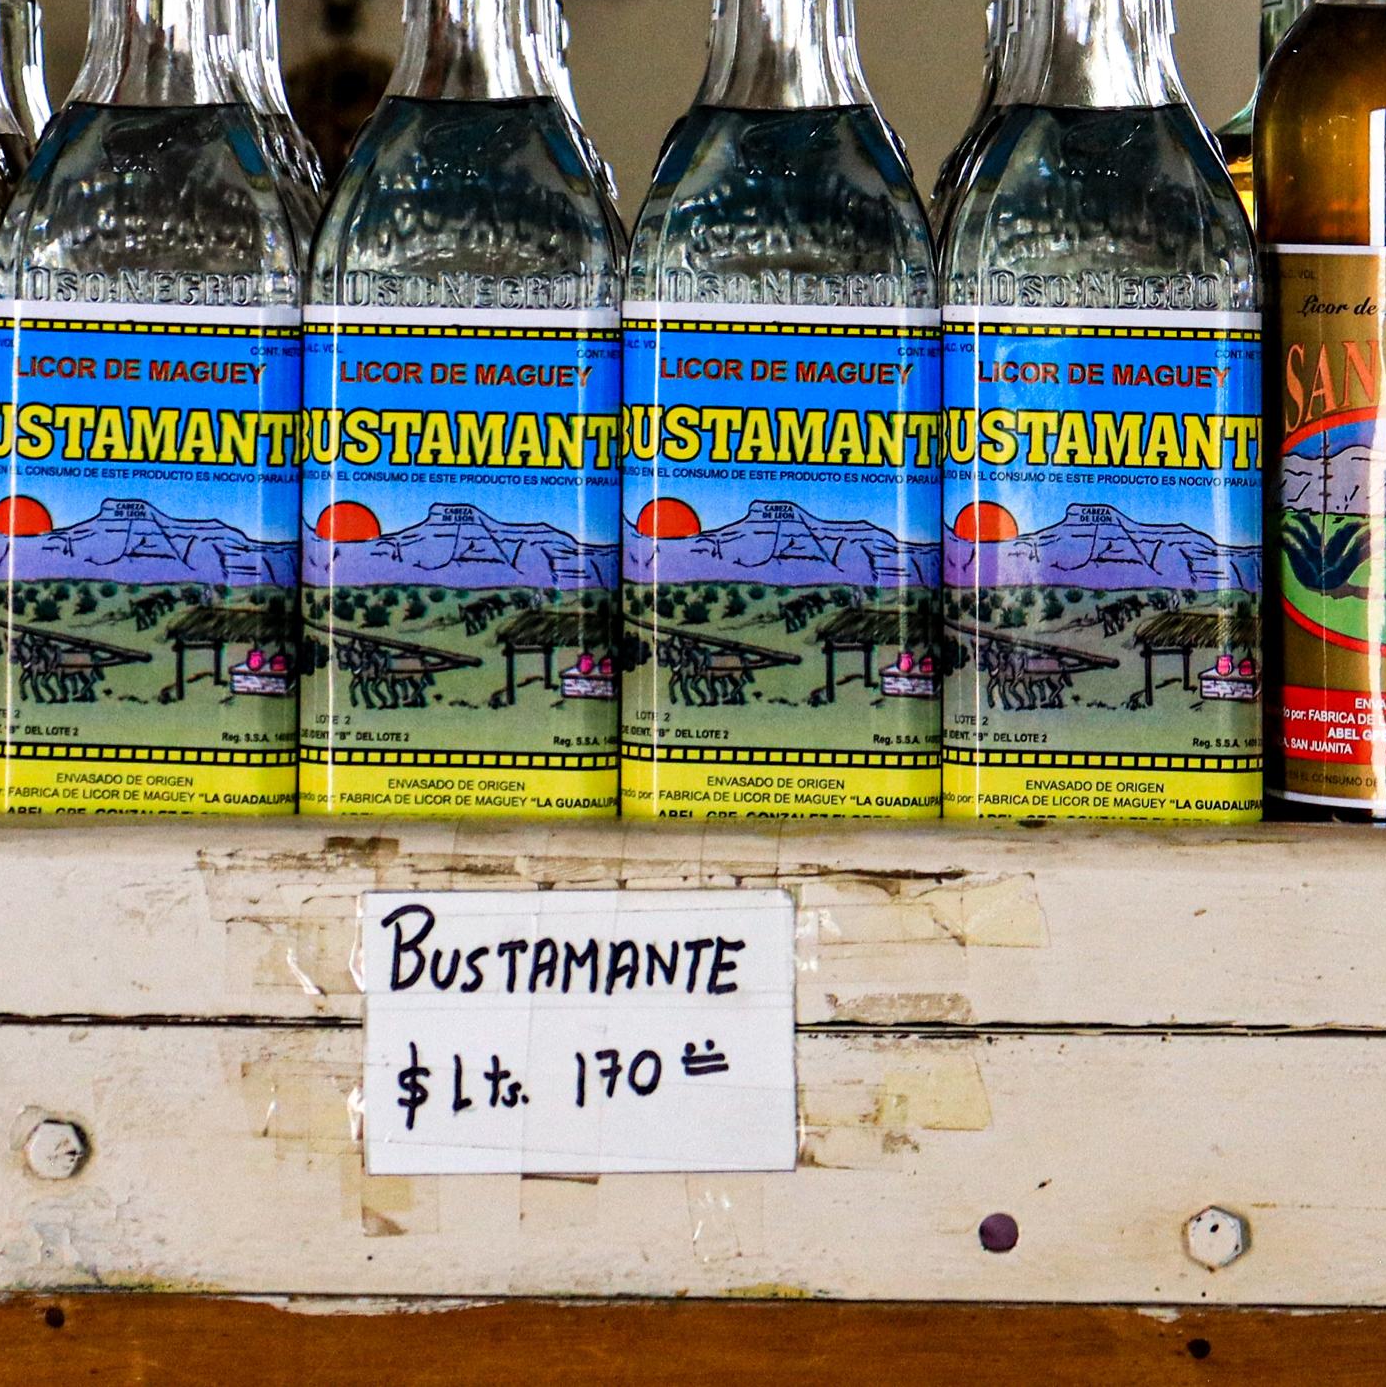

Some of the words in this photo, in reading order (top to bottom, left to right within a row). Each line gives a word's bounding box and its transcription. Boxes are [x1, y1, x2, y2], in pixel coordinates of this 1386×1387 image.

[1298, 294, 1348, 317] Licor
[1355, 297, 1376, 316] de
[15, 356, 97, 378] LICOR
[105, 360, 142, 380] DE
[150, 361, 266, 384] MAGUEY
[340, 362, 423, 384] LICOR
[432, 363, 467, 384] DE
[476, 365, 592, 387] MAGUEY
[661, 358, 743, 380] LICOR
[752, 360, 787, 381] DE
[796, 362, 913, 384] MAGUEY
[978, 362, 1059, 384] LICOR
[1068, 364, 1104, 385] DE
[1113, 365, 1230, 387] MAGUEY
[1286, 339, 1382, 436] SAN
[943, 407, 1262, 469] USTAMANT
[1327, 728, 1358, 740] ABEL
[56, 772, 122, 785] ENVASADO
[127, 775, 142, 785] DE
[146, 776, 193, 787] ORIGEN
[388, 779, 454, 790] ENVASADO
[459, 780, 473, 790] DE
[478, 780, 525, 791] ORIGEN
[707, 776, 774, 788] ENVASADO
[778, 777, 793, 788] DE
[797, 778, 845, 789] ORIGEN
[1026, 780, 1092, 791] ENVASADO
[1096, 781, 1112, 792] DE
[1117, 782, 1164, 793] ORIGEN
[978, 794, 1029, 806] FABRICA
[1032, 795, 1048, 806] DE
[1052, 796, 1089, 807] LICOR
[1093, 796, 1108, 808] DE
[1114, 797, 1166, 809] MAGUEY
[381, 903, 745, 995] BUSTAMANTE
